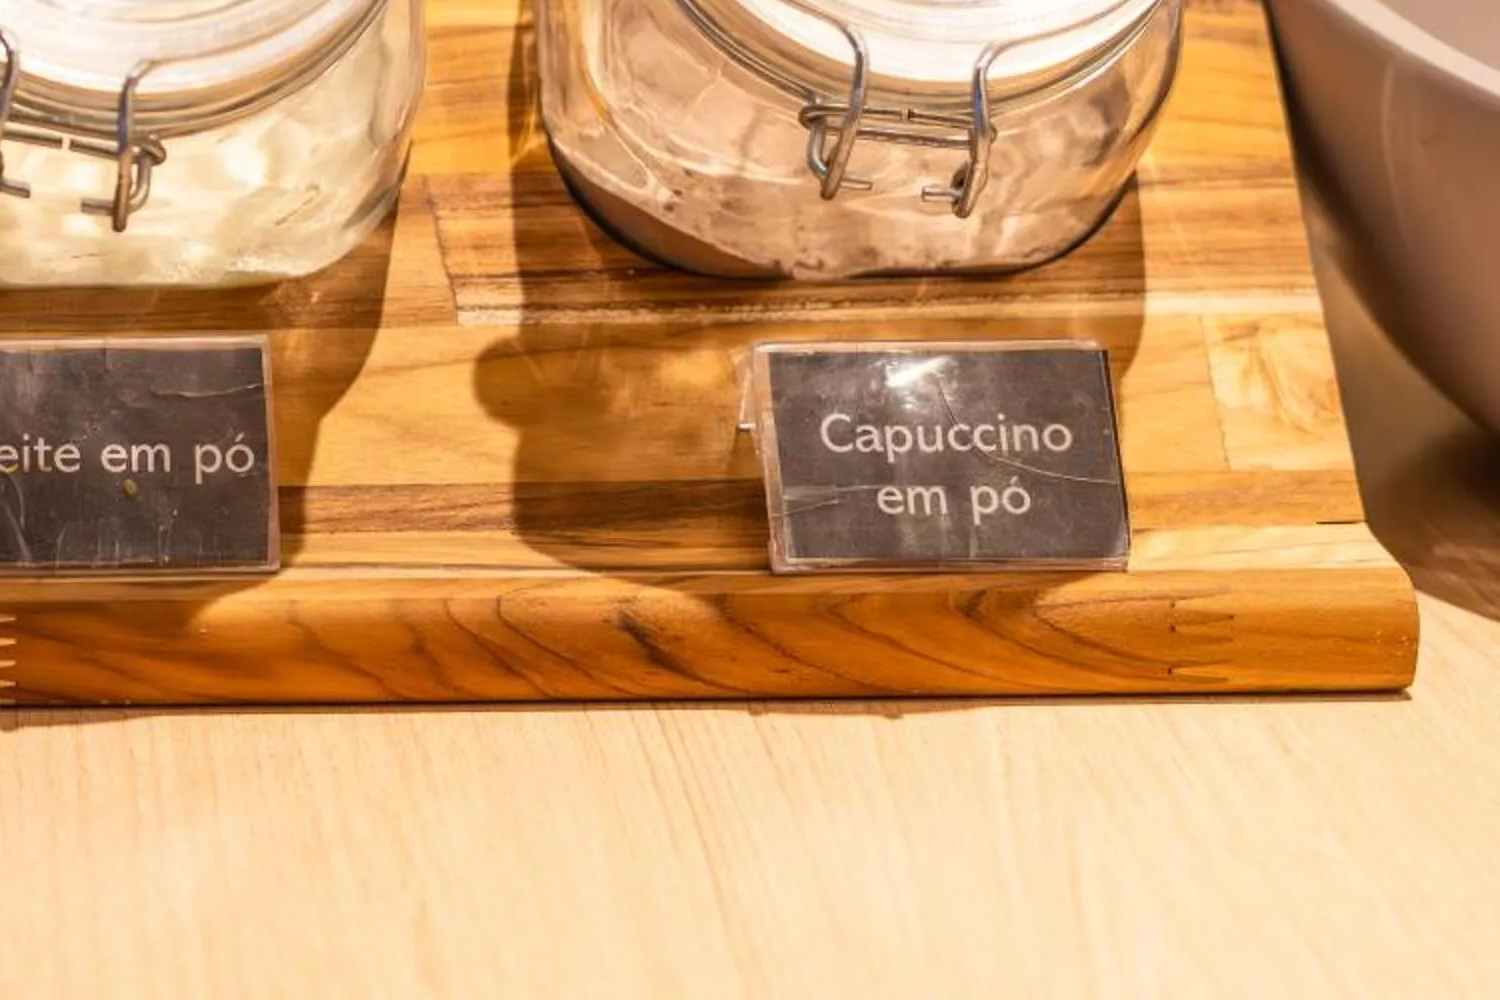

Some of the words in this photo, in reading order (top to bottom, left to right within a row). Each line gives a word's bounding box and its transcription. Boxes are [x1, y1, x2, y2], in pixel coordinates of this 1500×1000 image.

[100, 442, 171, 474] em
[194, 431, 255, 485] pó
[819, 412, 1074, 464] Capuccino
[876, 484, 947, 516] em
[970, 474, 1032, 526] pó
